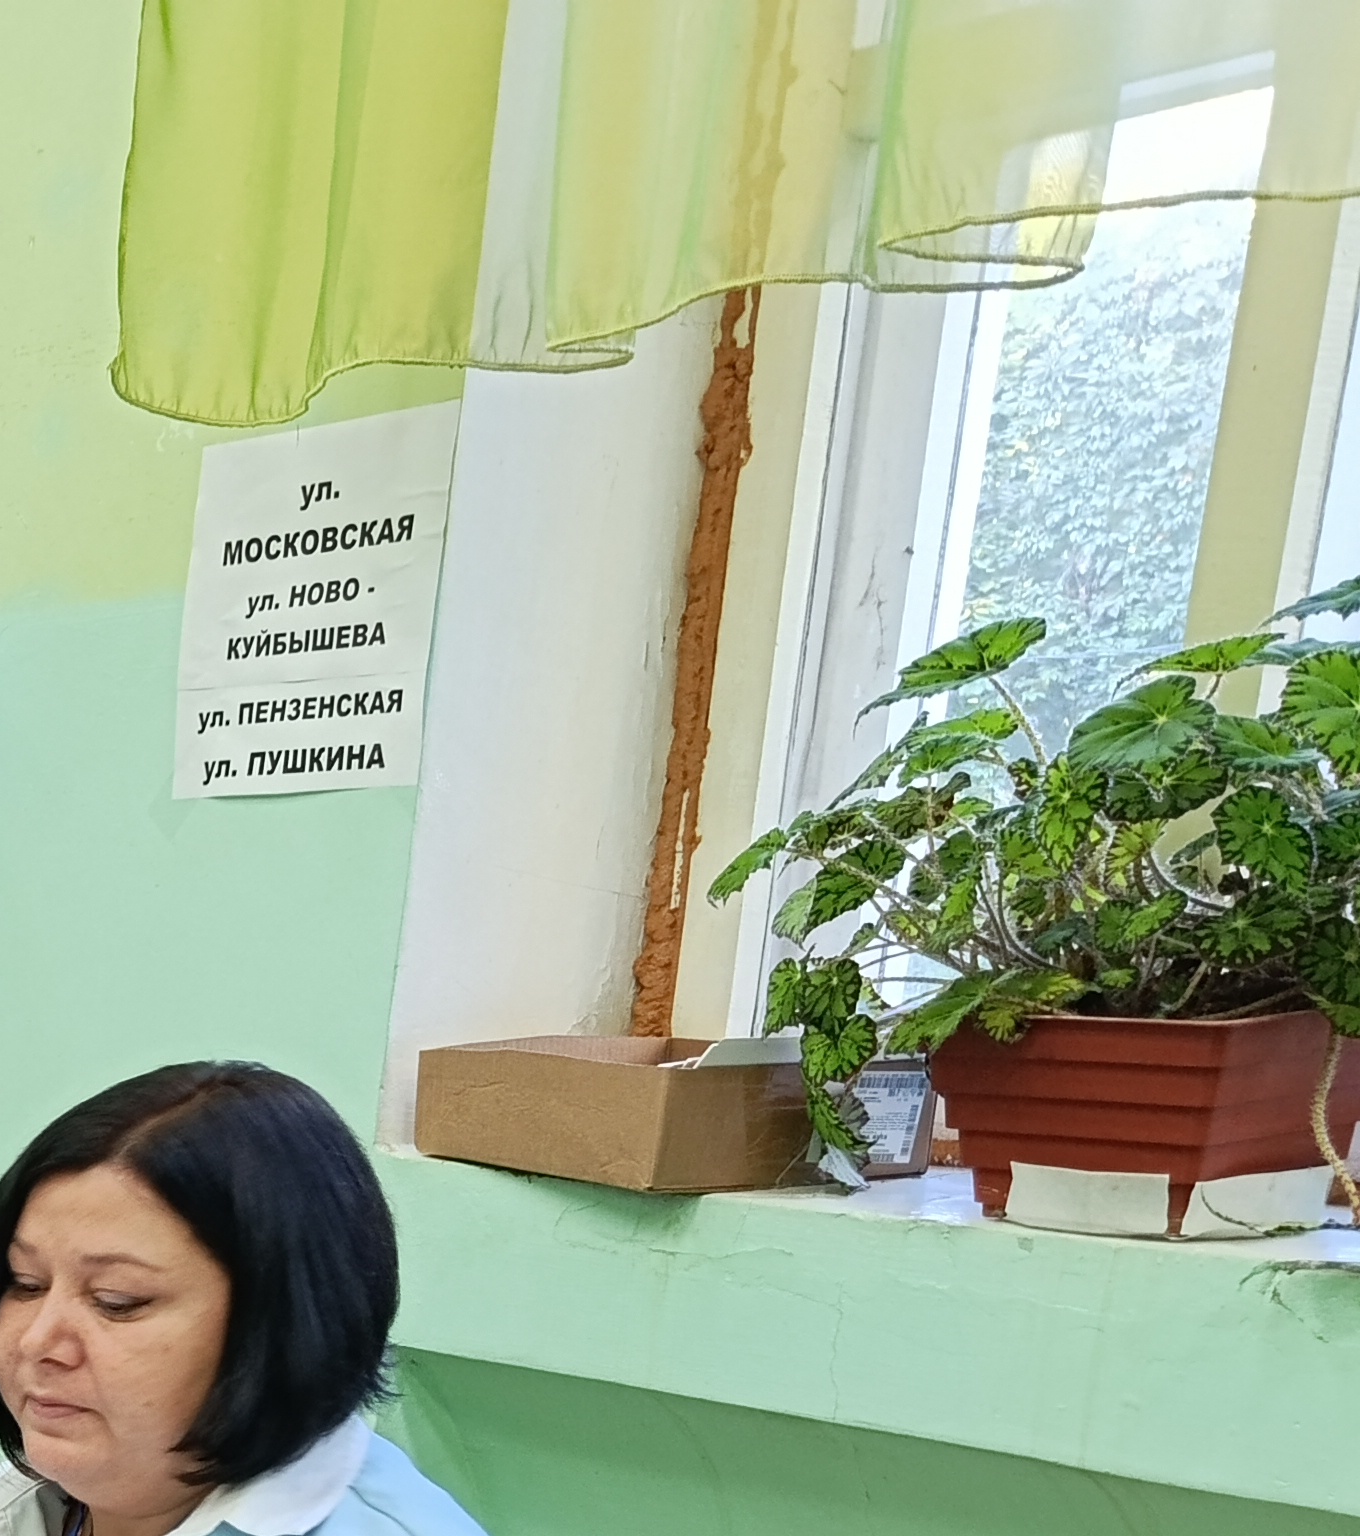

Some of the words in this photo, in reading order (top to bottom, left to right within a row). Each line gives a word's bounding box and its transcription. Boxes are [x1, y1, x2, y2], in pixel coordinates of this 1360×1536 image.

[300, 481, 340, 511] ул.
[222, 513, 415, 566] МОСКОВСКАЯ
[245, 593, 280, 619] ул.
[289, 576, 360, 608] НОВО
[226, 621, 386, 661] КУЙБЫШЕВА
[198, 710, 230, 734] ул.
[238, 689, 403, 726] ПЕНЗЕНСКАЯ
[202, 759, 237, 785] ул.
[247, 743, 385, 776] ПУШКИНА
